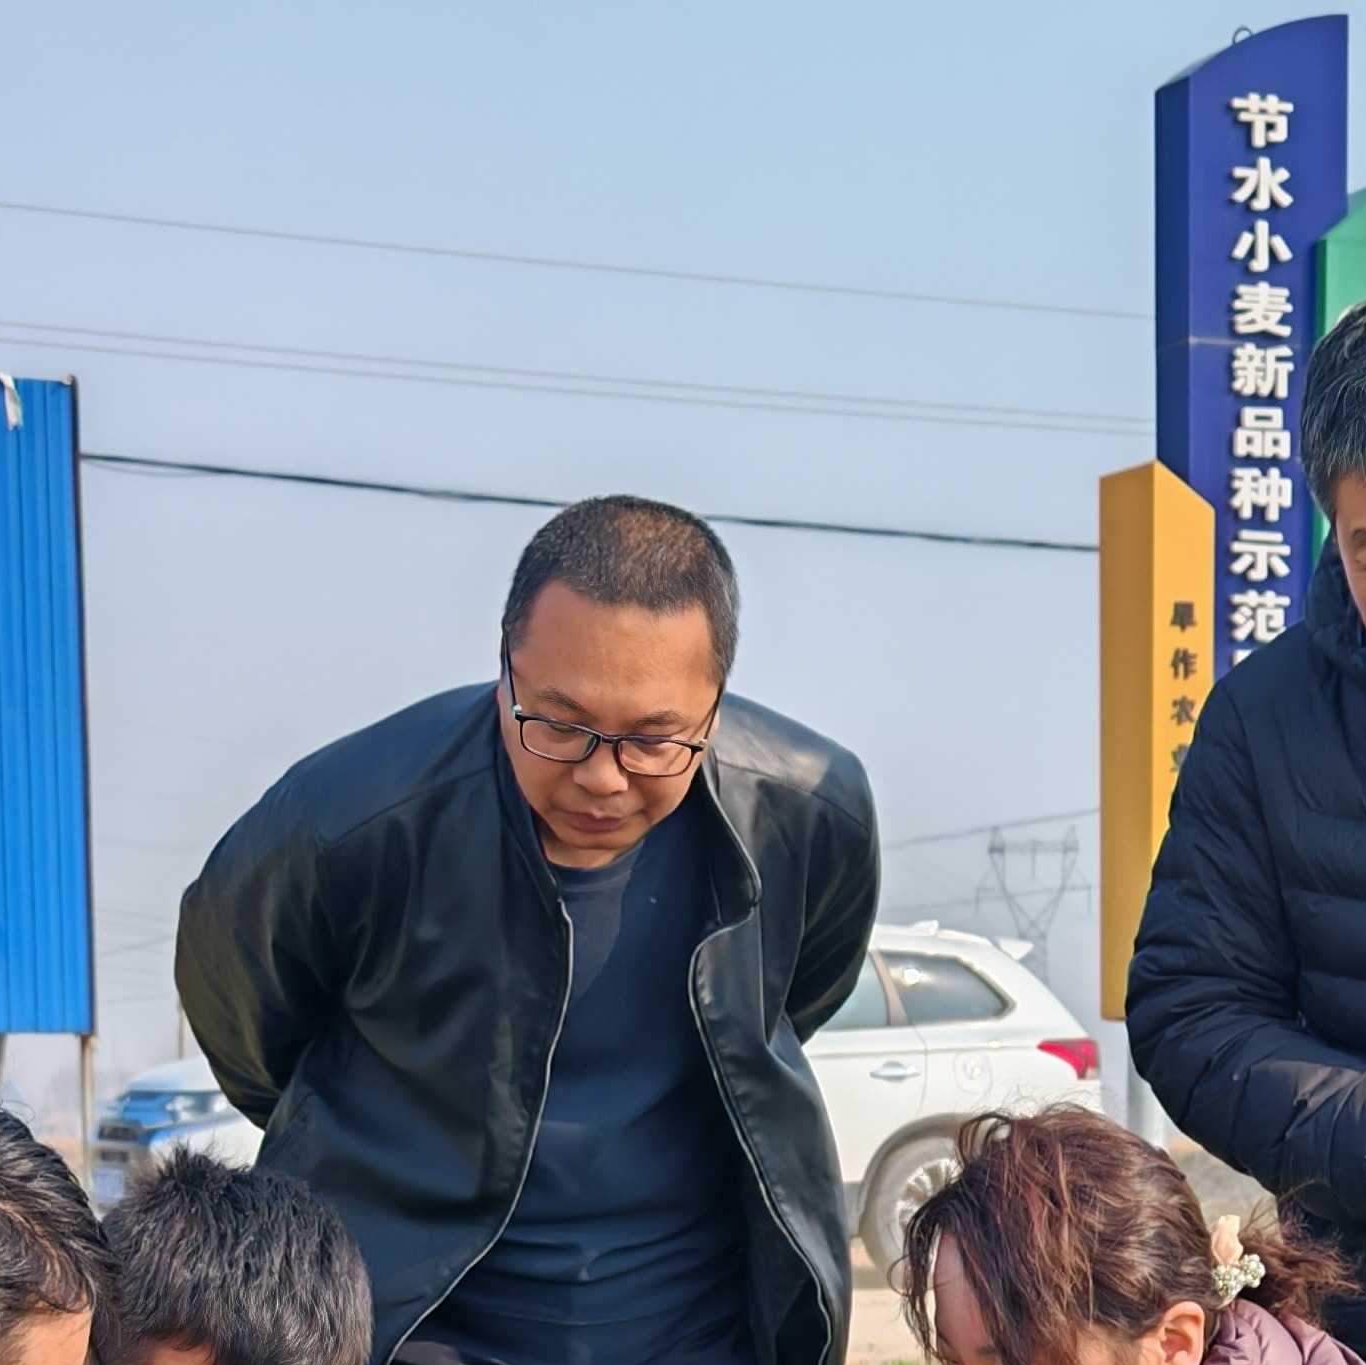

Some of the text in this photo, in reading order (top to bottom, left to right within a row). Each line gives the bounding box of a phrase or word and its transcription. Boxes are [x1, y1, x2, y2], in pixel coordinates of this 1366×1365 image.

[1231, 92, 1294, 667] 节水小麦新品种示范
